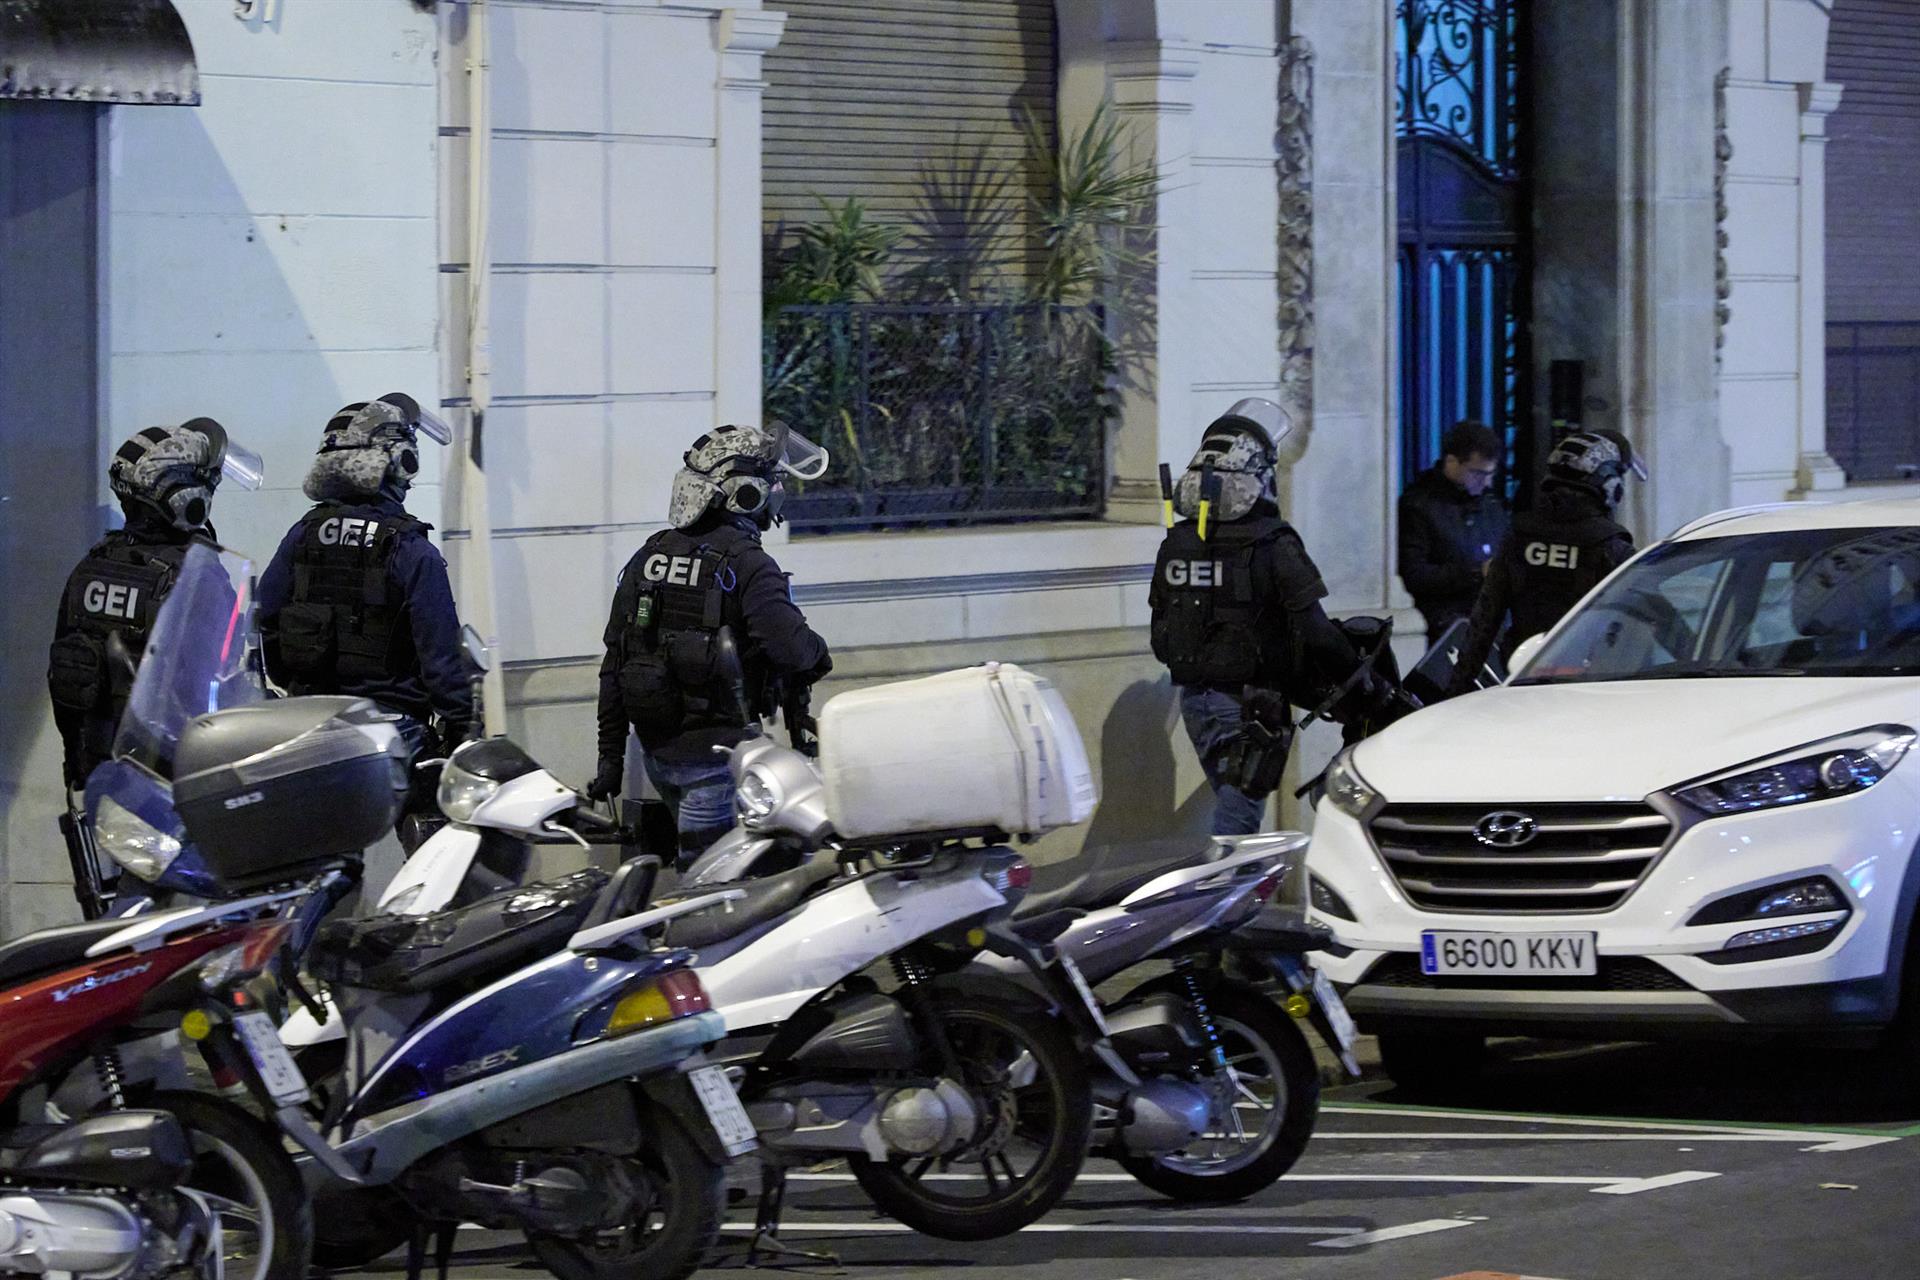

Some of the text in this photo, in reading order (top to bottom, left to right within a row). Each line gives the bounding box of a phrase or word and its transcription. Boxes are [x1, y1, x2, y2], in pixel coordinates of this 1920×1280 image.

[318, 517, 379, 548] GEI
[643, 553, 702, 587] GEI
[1524, 542, 1579, 570] GEI
[1165, 560, 1223, 586] GEI
[83, 580, 139, 619] GEI
[1443, 938, 1584, 969] 6600 KKV
